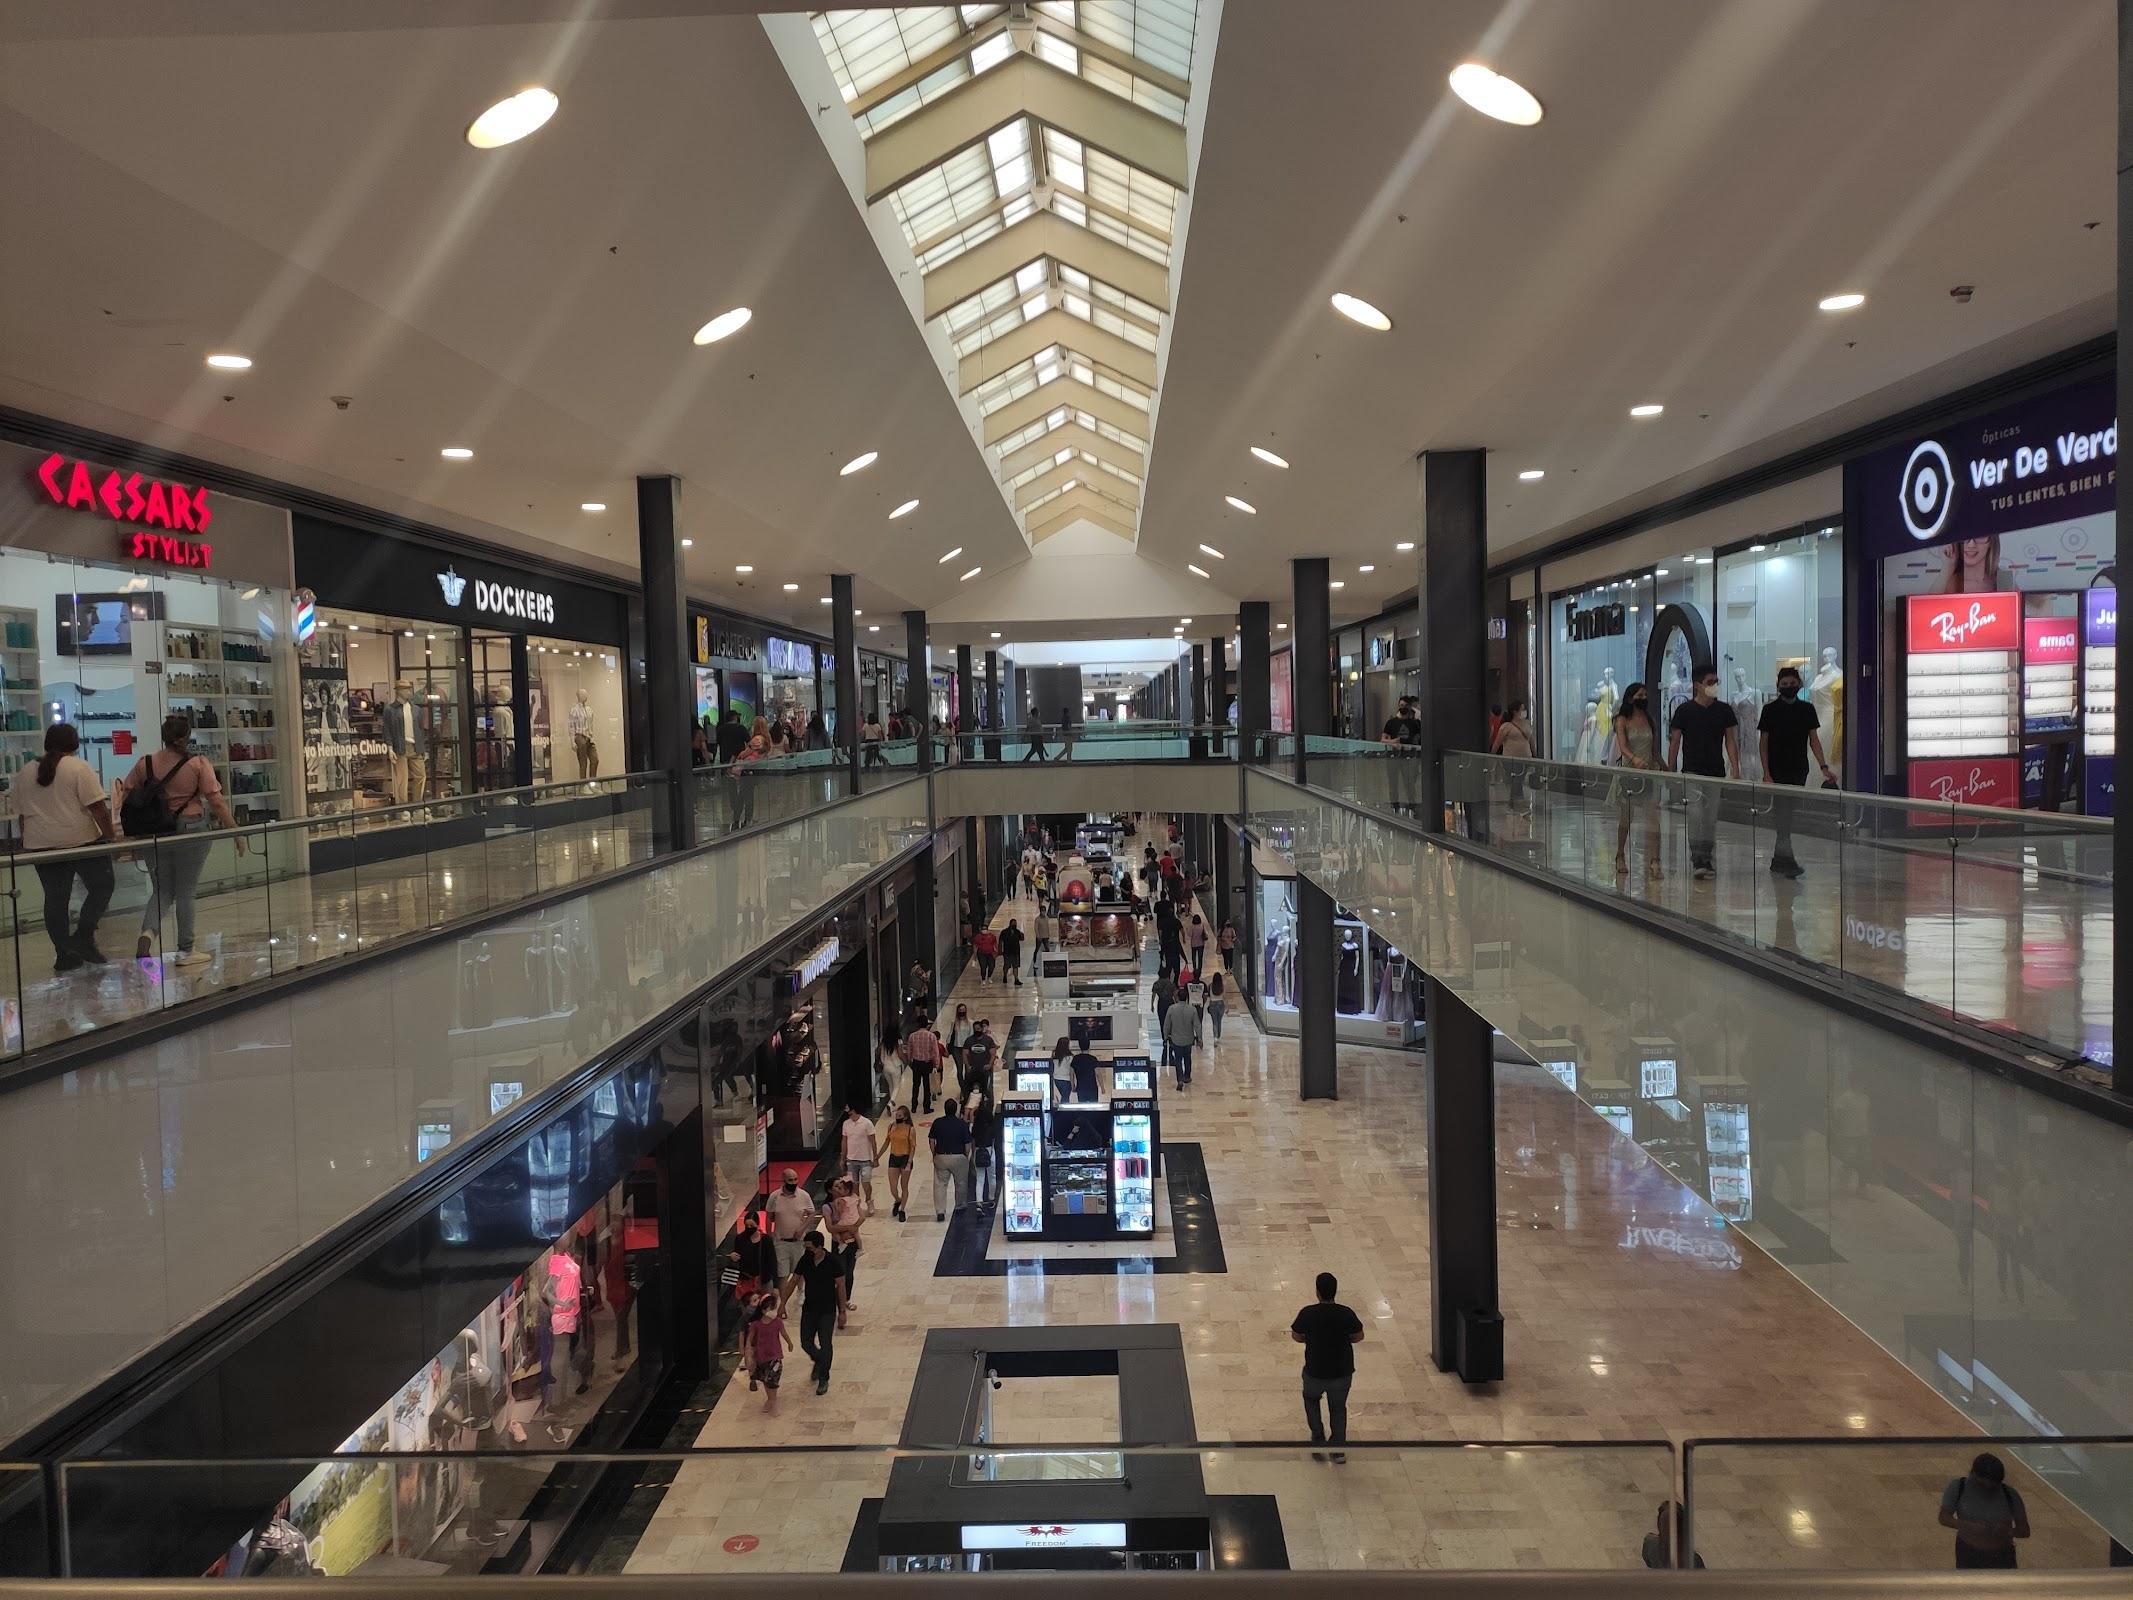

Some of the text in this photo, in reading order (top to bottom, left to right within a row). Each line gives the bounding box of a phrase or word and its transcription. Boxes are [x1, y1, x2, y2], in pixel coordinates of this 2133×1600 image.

[1970, 417, 2117, 489] Ver De Verd
[1983, 425, 2021, 444] Ópticas
[38, 452, 212, 533] CAESARS
[1991, 494, 2014, 511] TUS
[2018, 482, 2066, 505] LENTES,
[2070, 474, 2102, 494] BIEN
[132, 532, 212, 569] STYLIST
[475, 579, 555, 624] DOCKERS
[317, 742, 358, 760] Heritage
[360, 739, 388, 755] Chino
[1005, 1102, 1040, 1110] TOP CASE
[1114, 1101, 1150, 1109] TOP CASE
